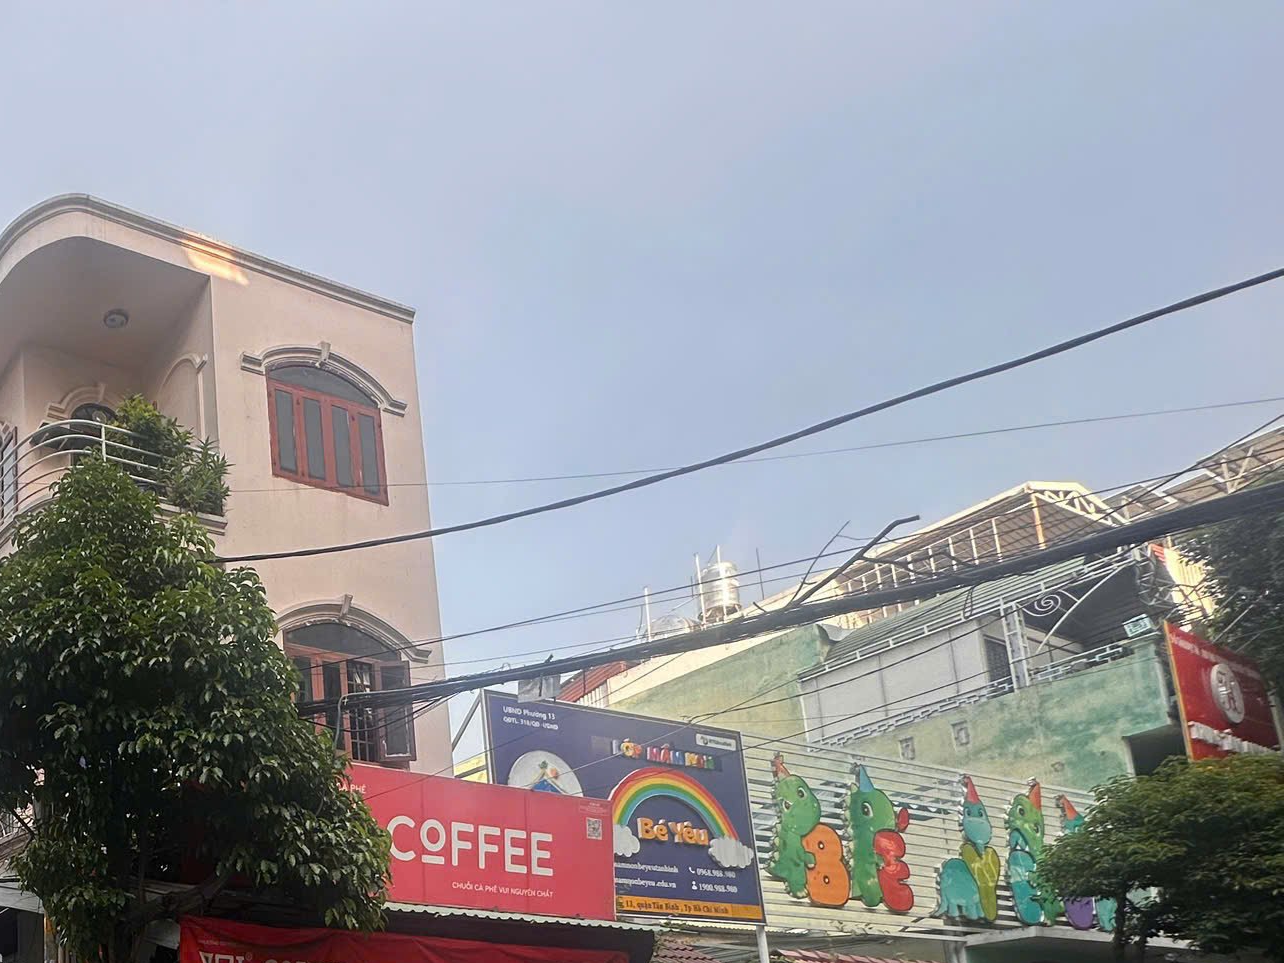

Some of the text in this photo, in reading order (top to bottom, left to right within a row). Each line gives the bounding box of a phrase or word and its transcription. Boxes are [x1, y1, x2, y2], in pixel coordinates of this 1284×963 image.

[386, 815, 554, 877] COFFEE
[636, 817, 709, 845] Bé Yêu
